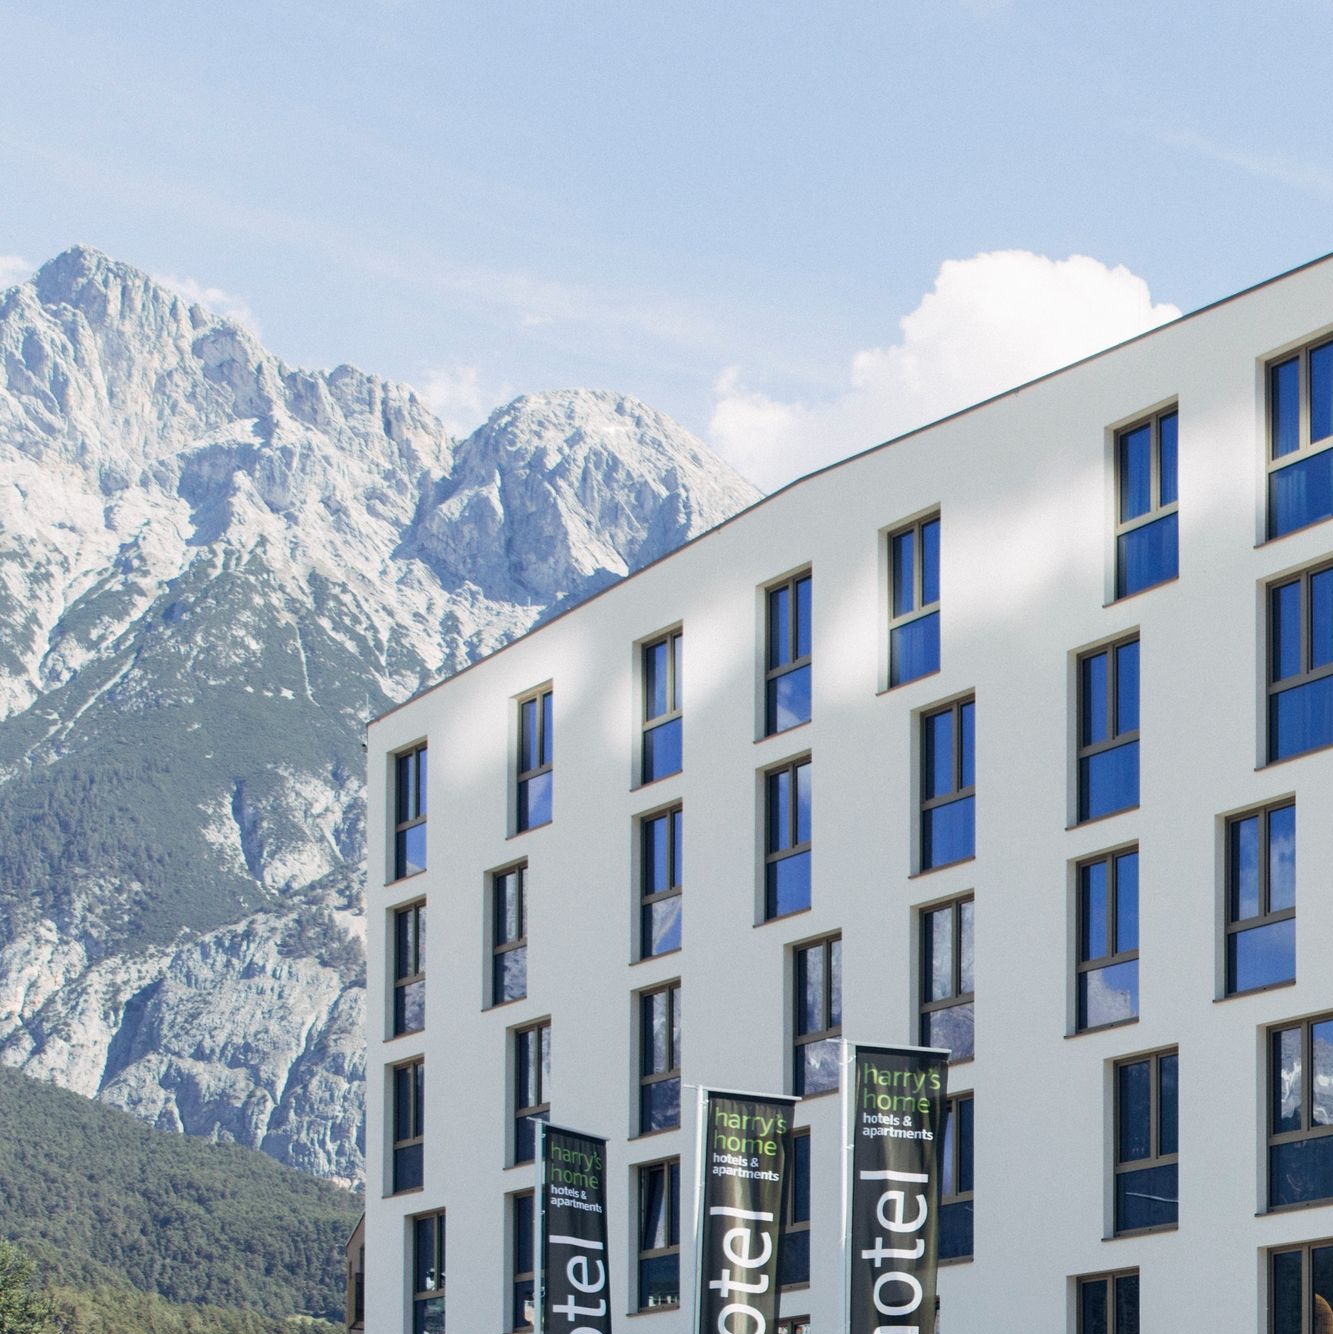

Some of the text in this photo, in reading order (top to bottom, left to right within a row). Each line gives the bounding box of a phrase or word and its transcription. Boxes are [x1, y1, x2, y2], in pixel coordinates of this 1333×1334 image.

[864, 1063, 941, 1093] harry's
[863, 1087, 931, 1114] home
[715, 1106, 787, 1137] harry's
[862, 1112, 912, 1127] hotels &
[713, 1130, 777, 1156] home
[862, 1127, 934, 1140] apartments
[551, 1141, 602, 1172] harry's
[713, 1153, 759, 1168] hotels &
[551, 1163, 599, 1189] home
[712, 1166, 780, 1181] apartments
[550, 1184, 587, 1200] hotels &
[550, 1197, 603, 1213] apartments
